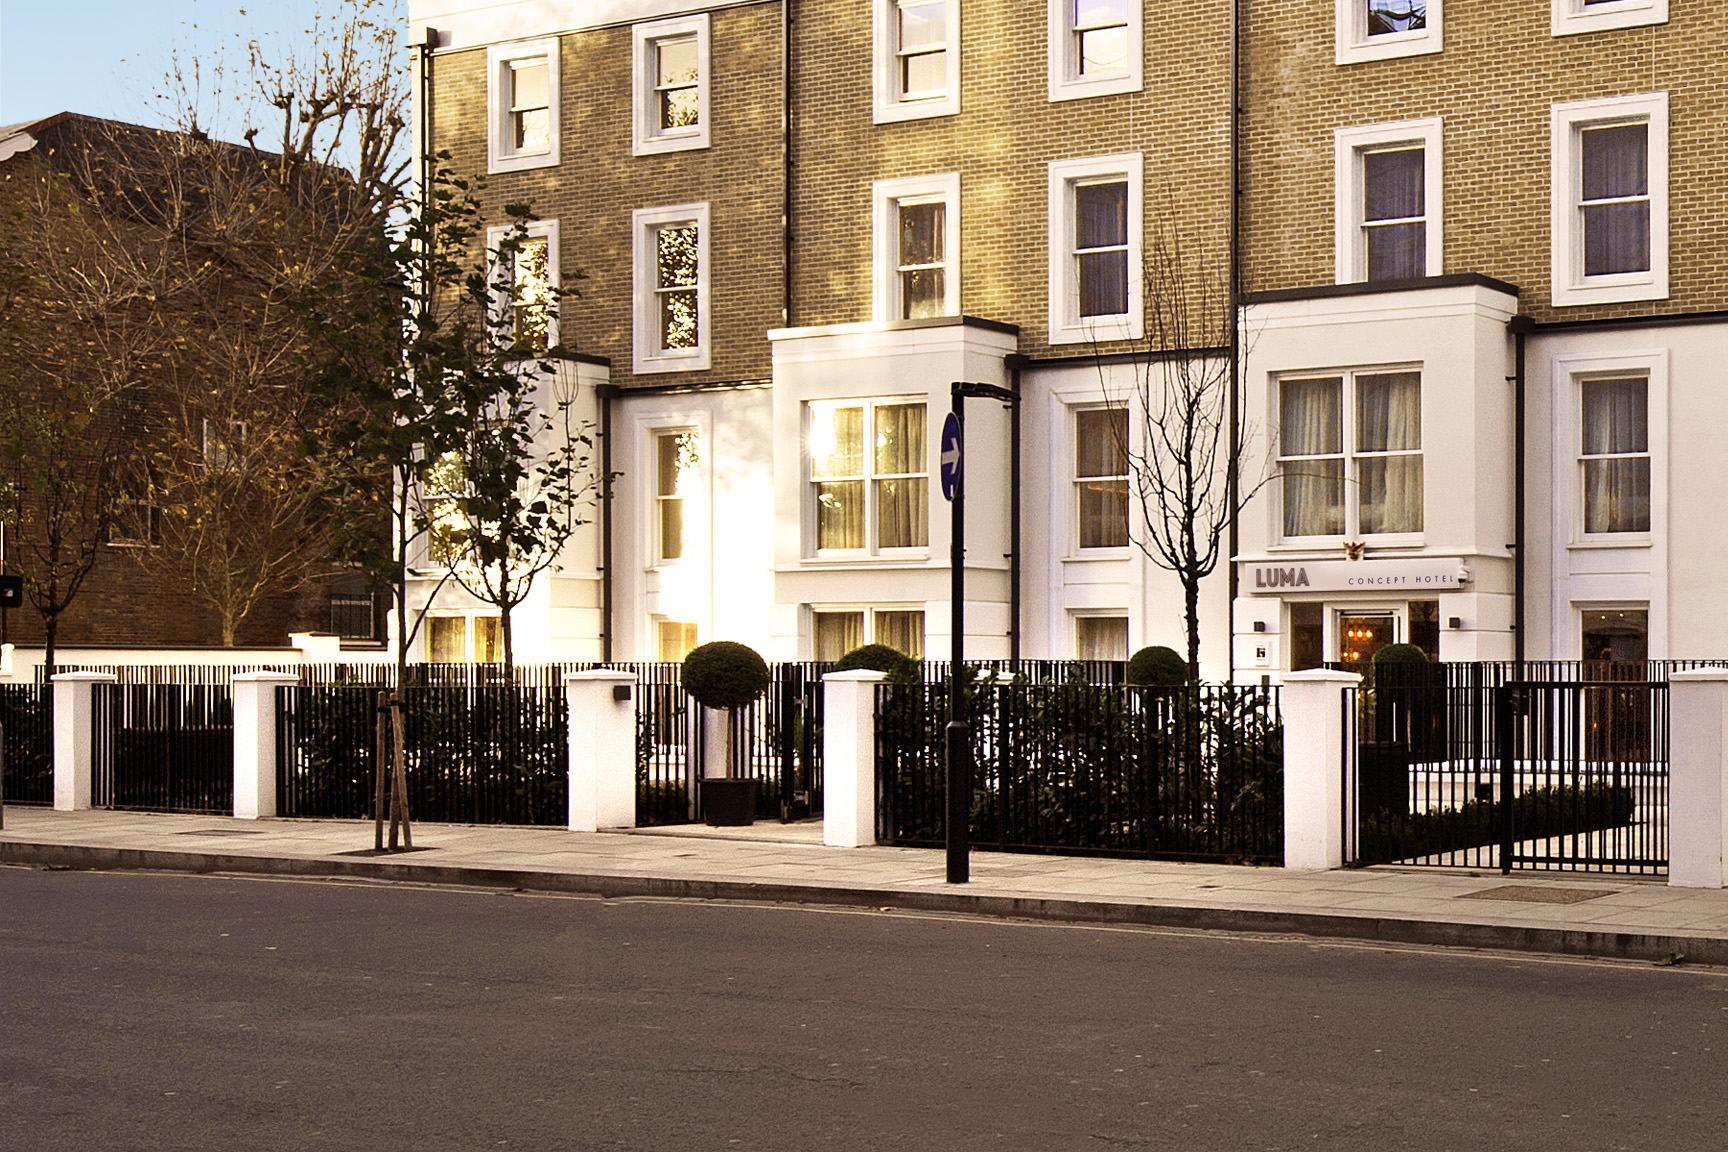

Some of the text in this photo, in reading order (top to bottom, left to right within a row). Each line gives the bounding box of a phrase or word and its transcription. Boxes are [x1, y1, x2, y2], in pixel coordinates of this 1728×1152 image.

[1255, 567, 1454, 588] LUMA CONCEPT HOTEL
